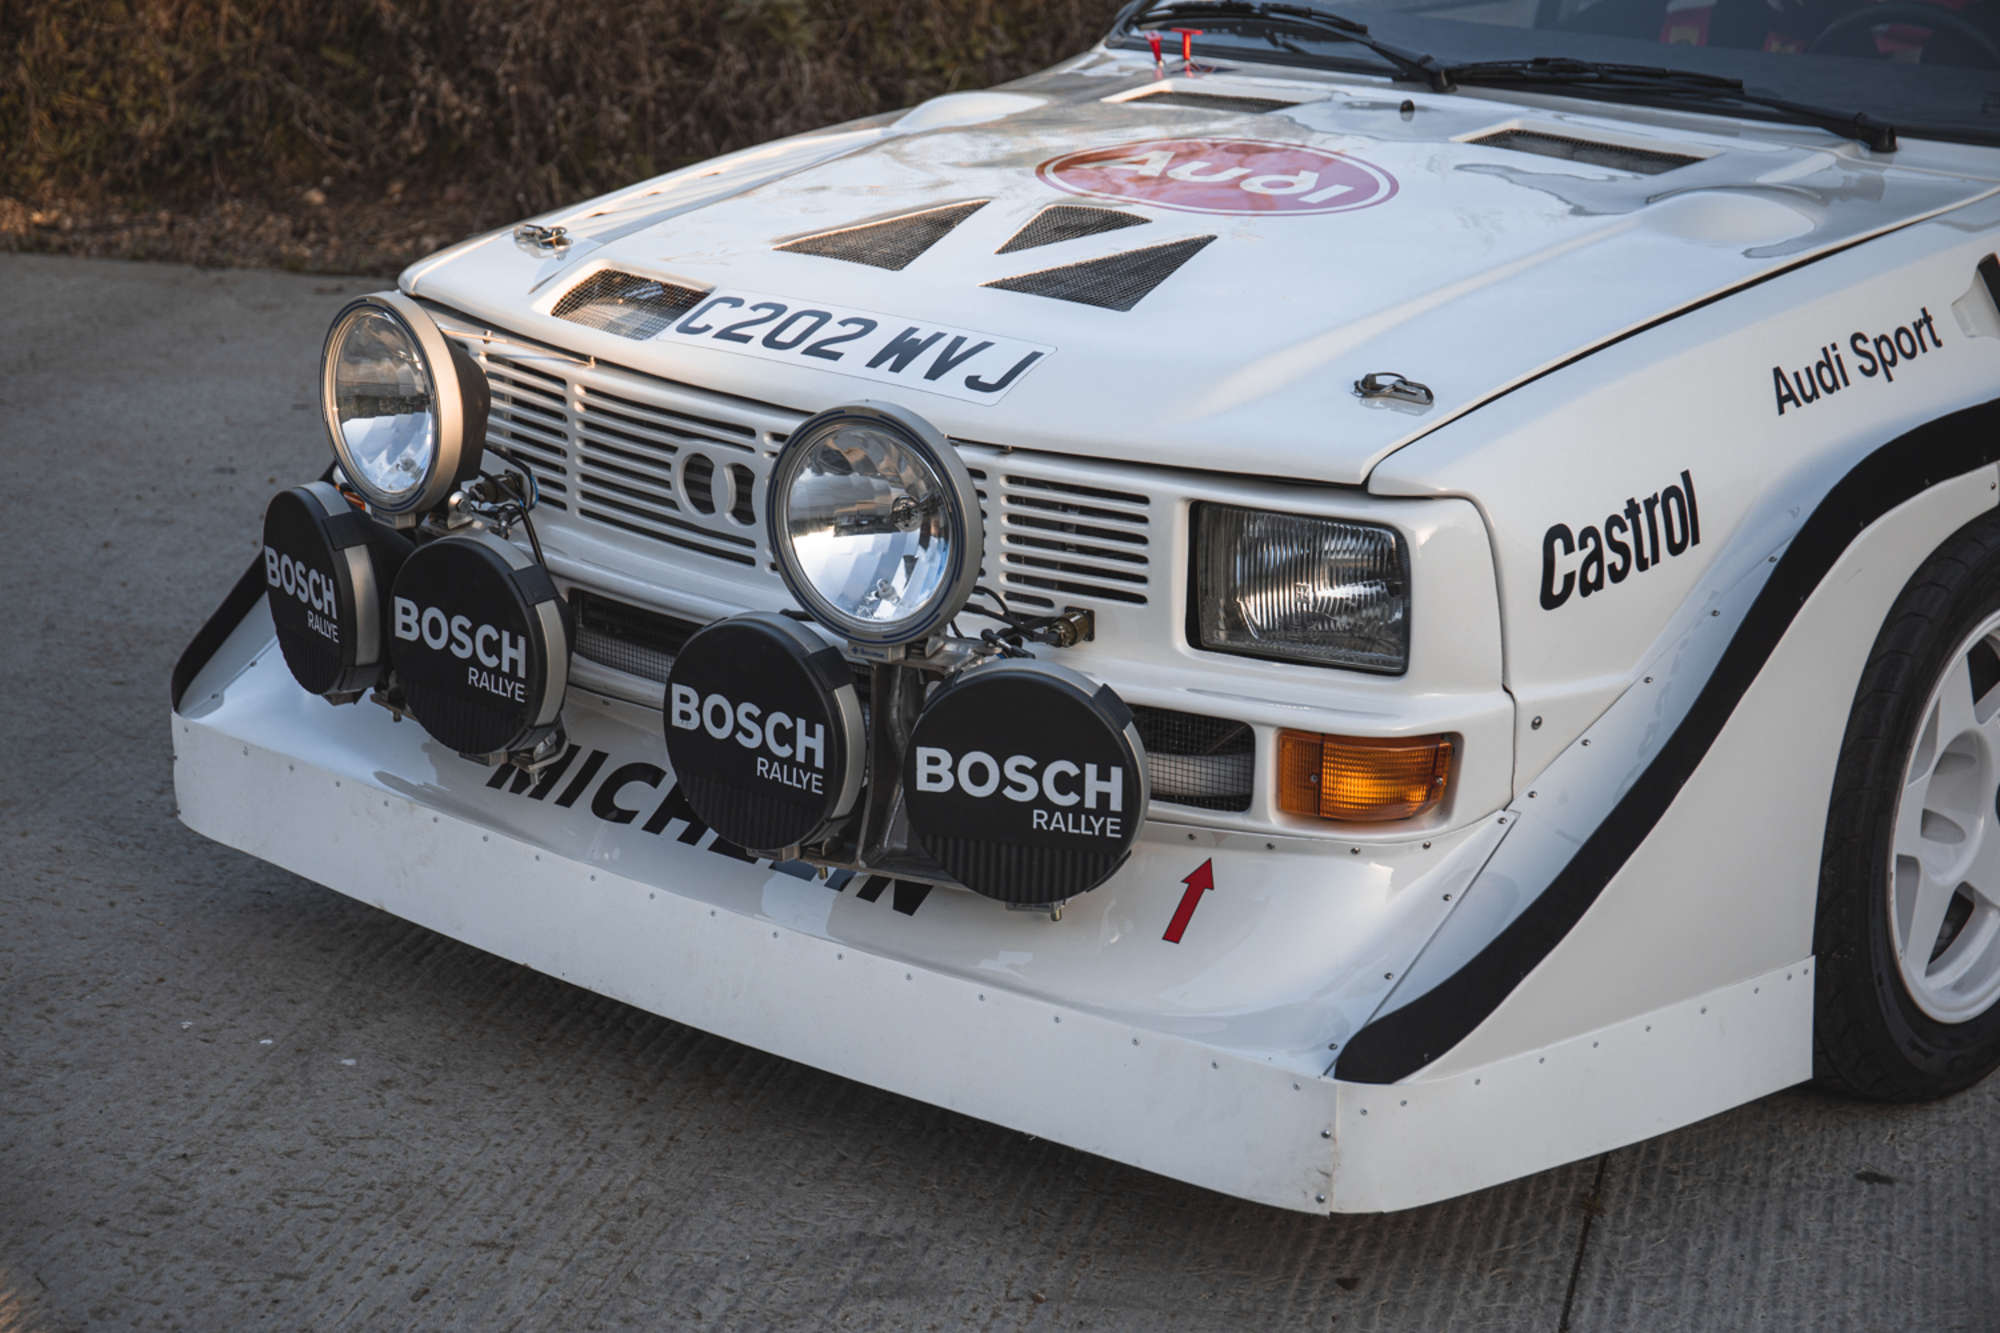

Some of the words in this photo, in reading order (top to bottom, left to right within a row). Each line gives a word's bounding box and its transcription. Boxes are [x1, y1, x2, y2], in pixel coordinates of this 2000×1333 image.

[1068, 150, 1355, 204] Audi
[674, 296, 879, 362] C202
[864, 326, 1045, 394] WVJ
[1772, 341, 1850, 416] Audi
[1850, 307, 1943, 382] Sport
[1538, 469, 1701, 611] Castrol
[264, 545, 338, 620] BOSCH
[307, 610, 340, 645] RALLYE
[394, 596, 527, 679] BOSCH
[468, 667, 526, 704] RALLYE
[671, 682, 825, 769] BOSCH
[756, 757, 824, 795] RALLYE
[916, 746, 1123, 812] BOSCH
[485, 743, 934, 916] MICH
[1032, 809, 1122, 839] RALLYE
